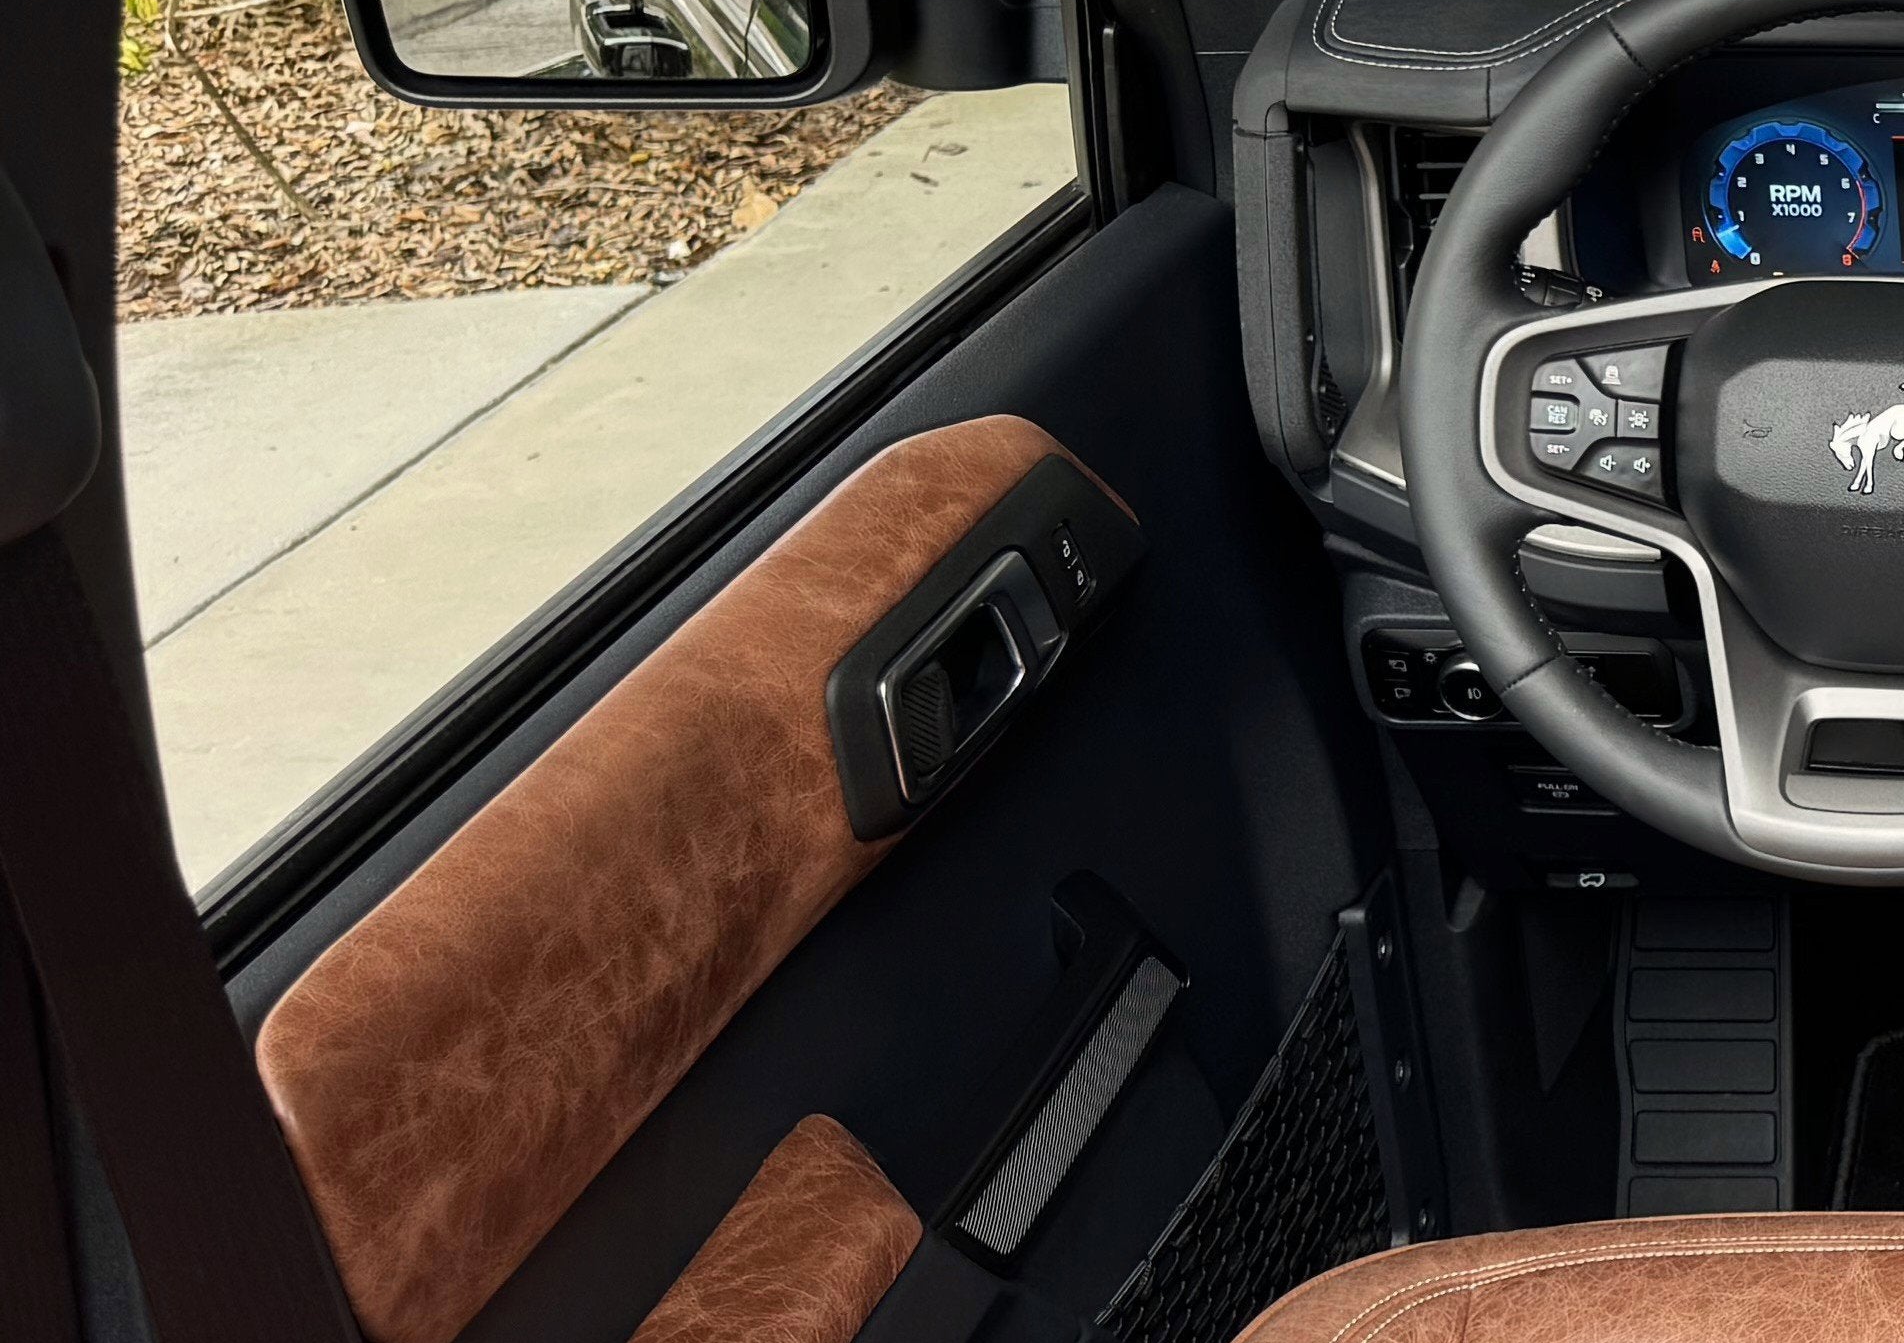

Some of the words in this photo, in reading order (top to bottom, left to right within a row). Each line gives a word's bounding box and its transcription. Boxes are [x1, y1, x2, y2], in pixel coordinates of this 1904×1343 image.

[1873, 114, 1880, 124] C
[1786, 144, 1796, 155] 4
[1755, 153, 1764, 165] 3
[1820, 154, 1829, 165] 5
[1737, 177, 1747, 188] 2
[1841, 178, 1850, 189] 6
[1769, 184, 1822, 203] RPM
[1772, 203, 1823, 217] X1000
[1738, 211, 1745, 222] 1
[1847, 212, 1856, 223] 7
[1750, 253, 1760, 265] 0
